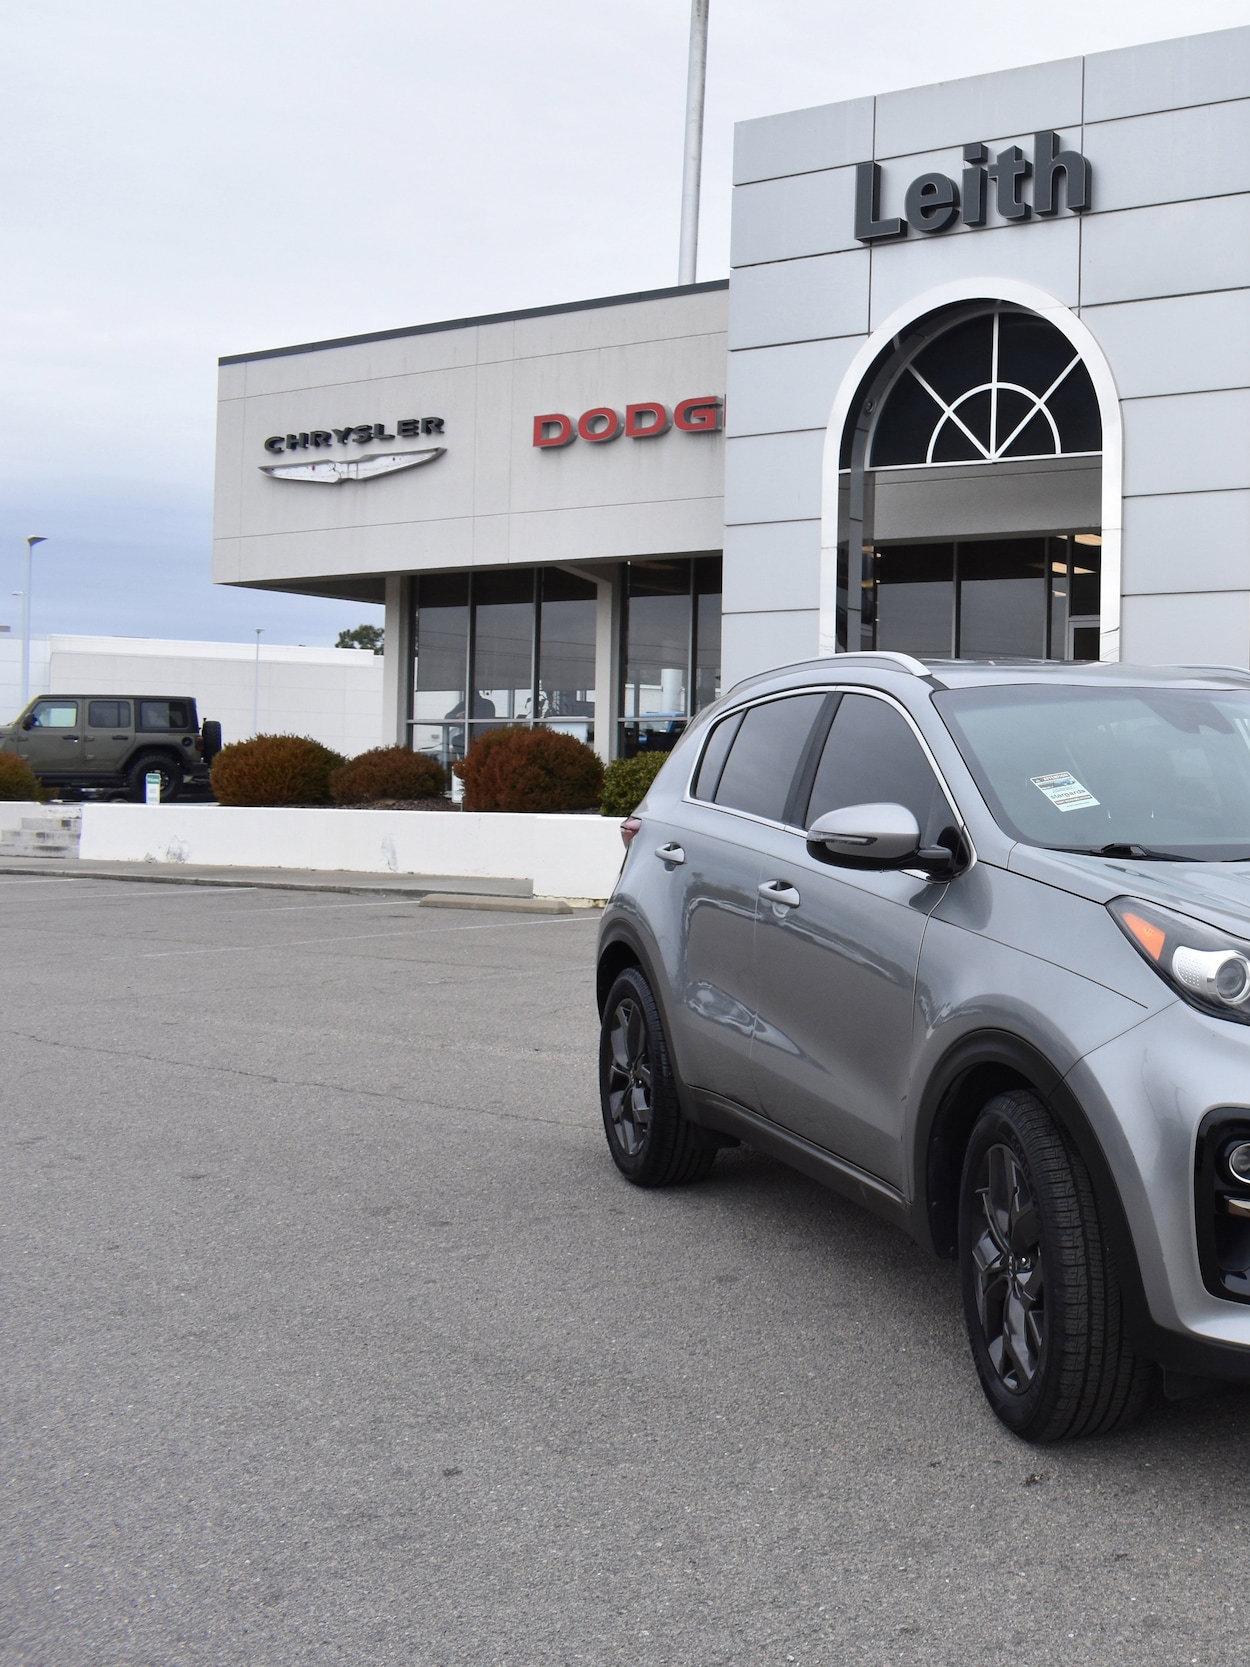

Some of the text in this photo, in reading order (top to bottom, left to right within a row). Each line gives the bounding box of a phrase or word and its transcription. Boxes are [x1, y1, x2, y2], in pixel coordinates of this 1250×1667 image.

[854, 130, 1092, 243] Leith
[264, 416, 445, 453] CHRYSLER
[533, 394, 727, 449] DODG
